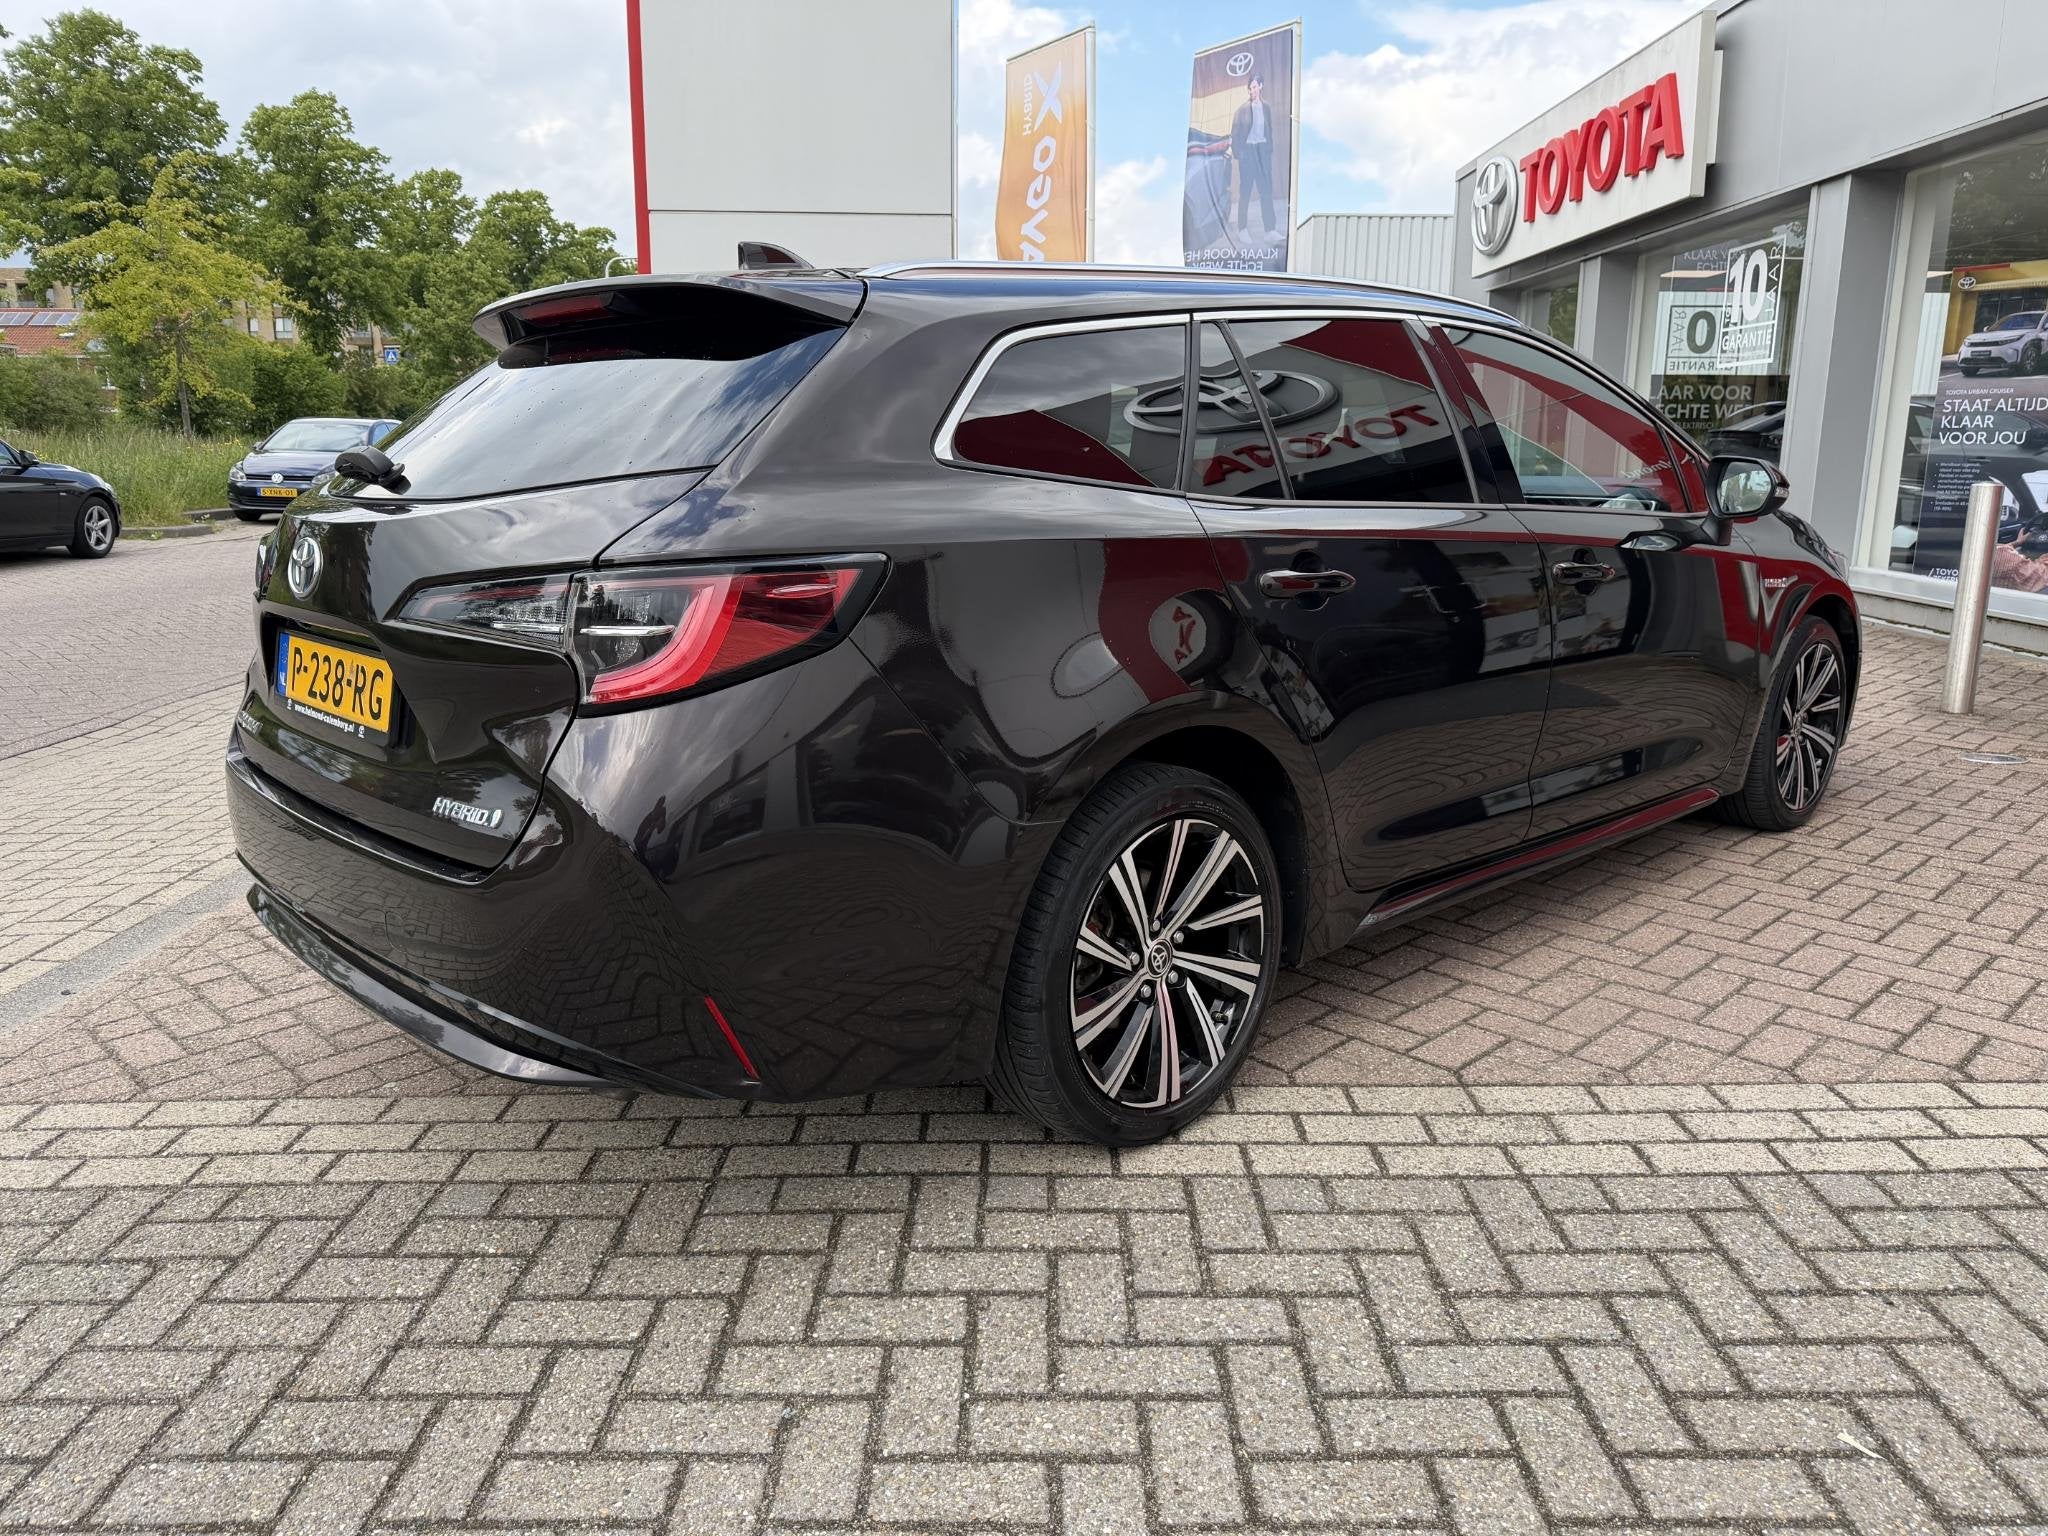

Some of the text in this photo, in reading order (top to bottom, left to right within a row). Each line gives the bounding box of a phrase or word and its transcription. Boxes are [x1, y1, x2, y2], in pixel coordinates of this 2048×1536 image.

[1520, 72, 1685, 223] TOYOTA
[1697, 261, 1728, 271] ECHT
[1728, 245, 1782, 323] 10 JAAR
[1722, 328, 1772, 351] GARANTIE
[1699, 385, 1752, 400] VOOR
[1942, 397, 2048, 413] STAAT ALTIJD
[1940, 415, 1994, 429] KLAAR
[1939, 431, 2027, 445] VOOR JOU
[1936, 568, 1959, 576] TOYO
[291, 646, 384, 721] P-238-RG
